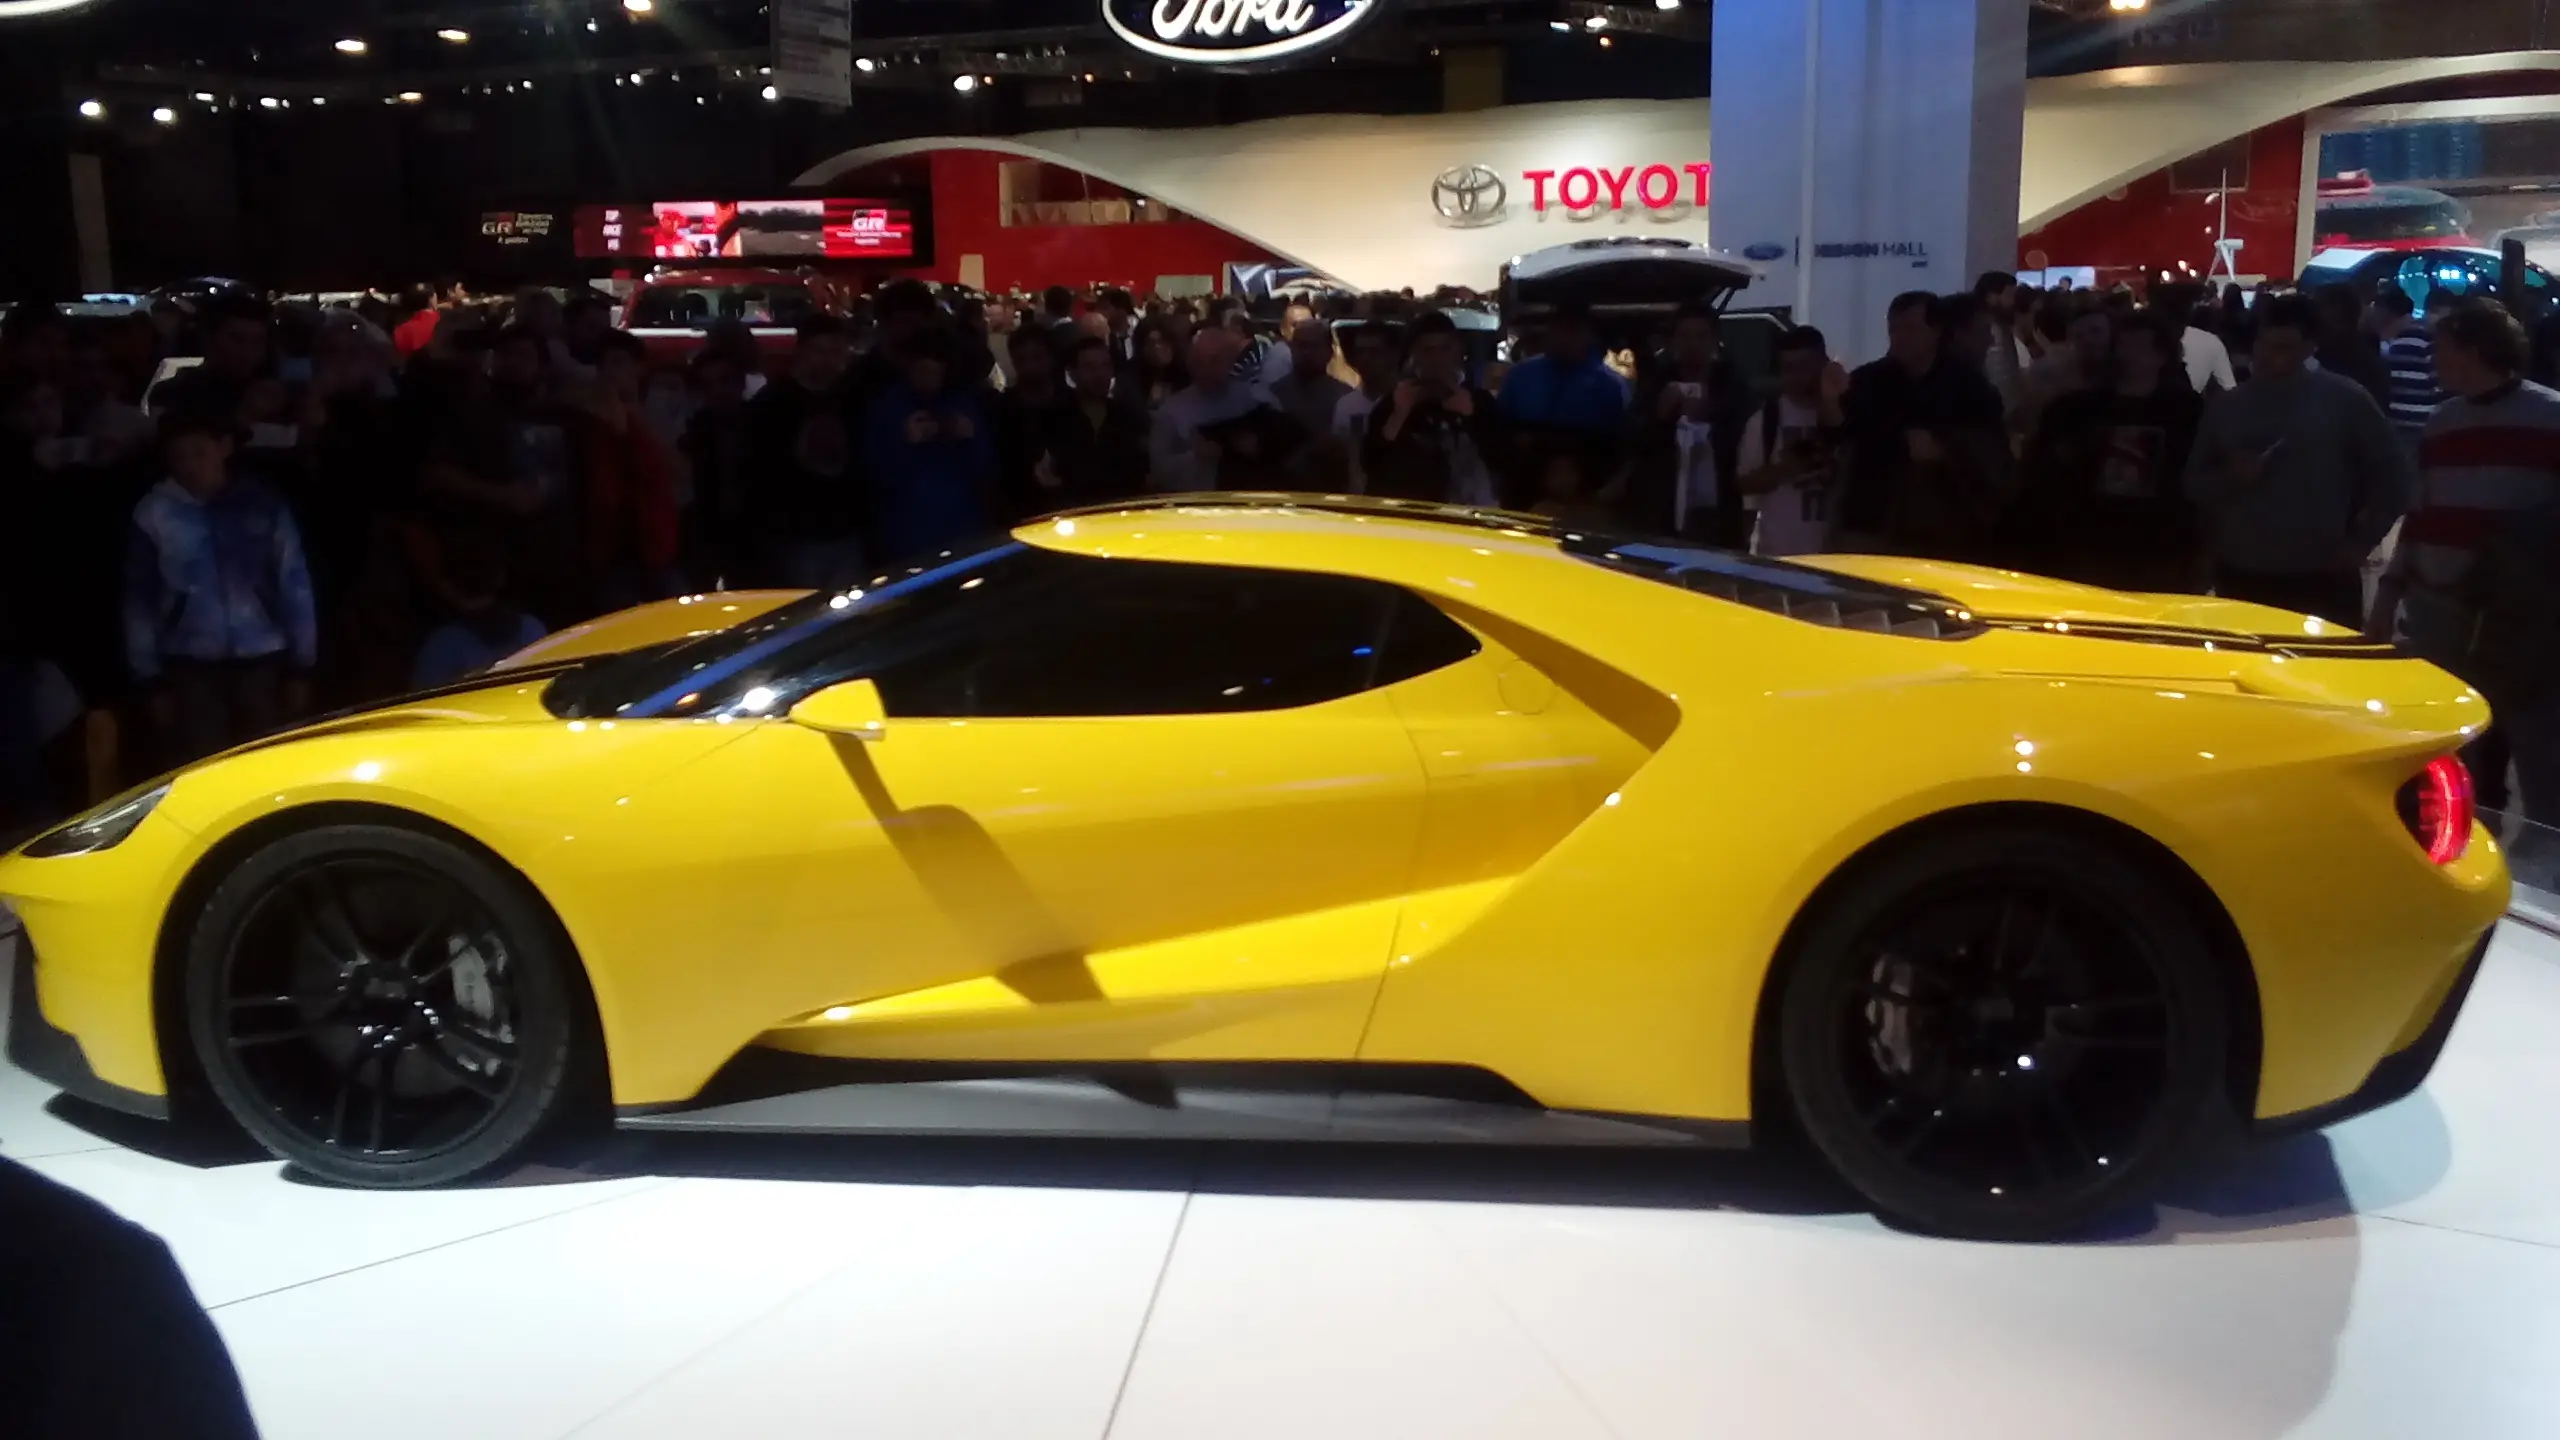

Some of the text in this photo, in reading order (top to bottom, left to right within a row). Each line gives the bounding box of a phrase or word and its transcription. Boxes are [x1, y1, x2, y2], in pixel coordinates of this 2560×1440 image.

[1152, 0, 1314, 39] Ford
[1522, 163, 1711, 212] TOYOT
[1883, 241, 1927, 256] HALL
